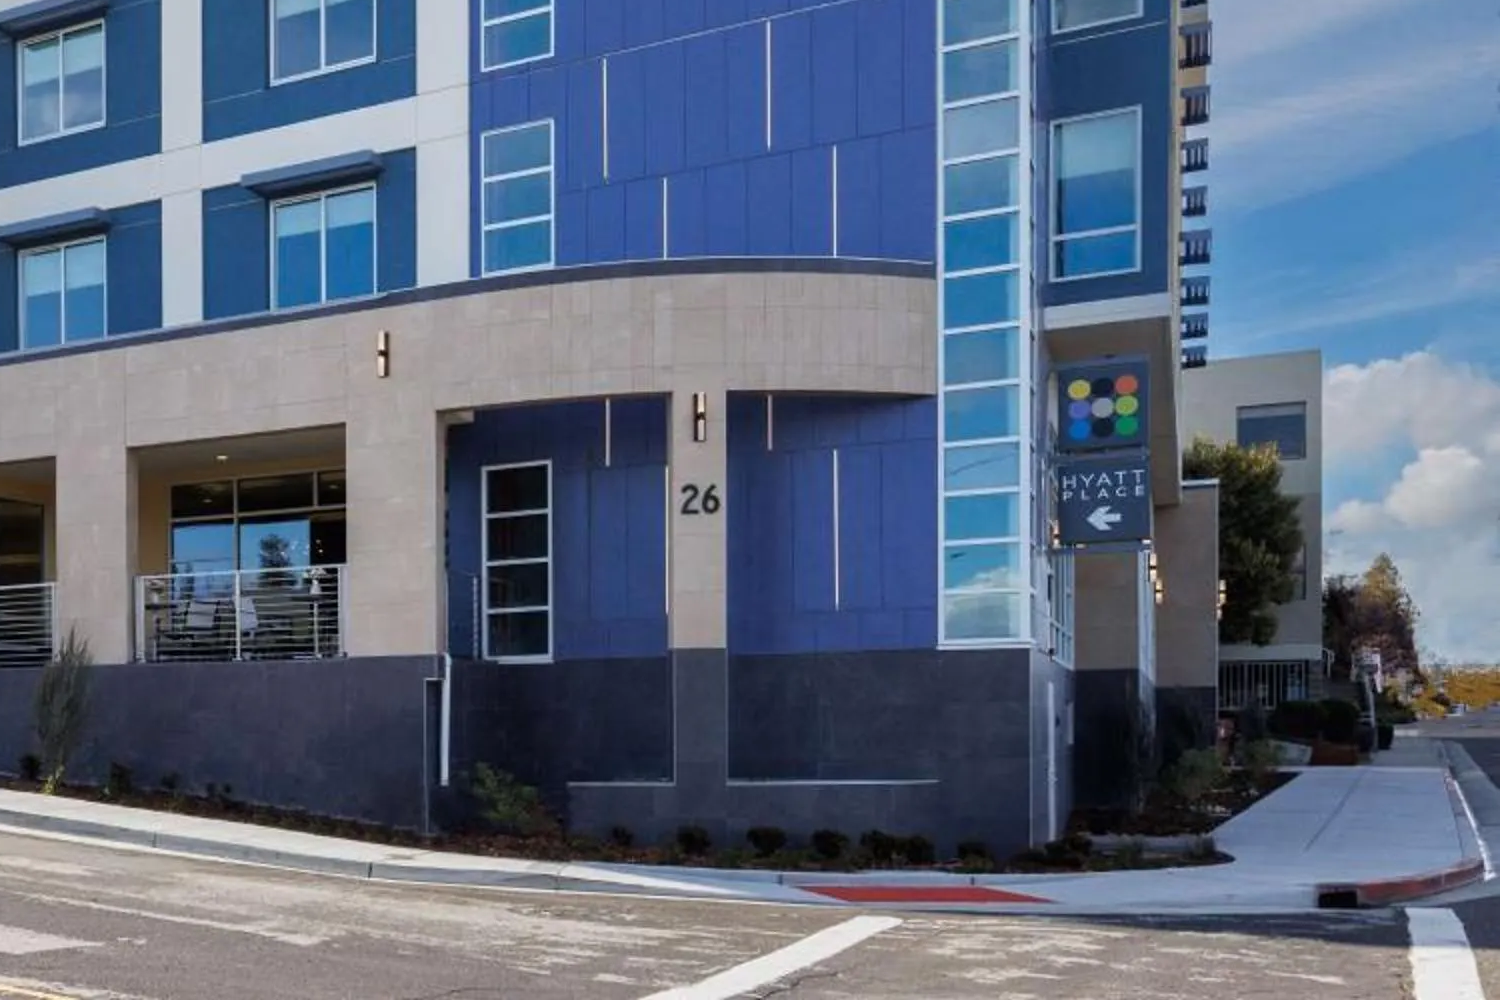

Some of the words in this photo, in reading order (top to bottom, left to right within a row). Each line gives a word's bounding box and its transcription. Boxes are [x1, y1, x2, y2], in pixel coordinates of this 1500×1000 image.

[1062, 469, 1145, 488] HYATT
[681, 484, 721, 515] 26
[1062, 486, 1145, 501] PLACE
